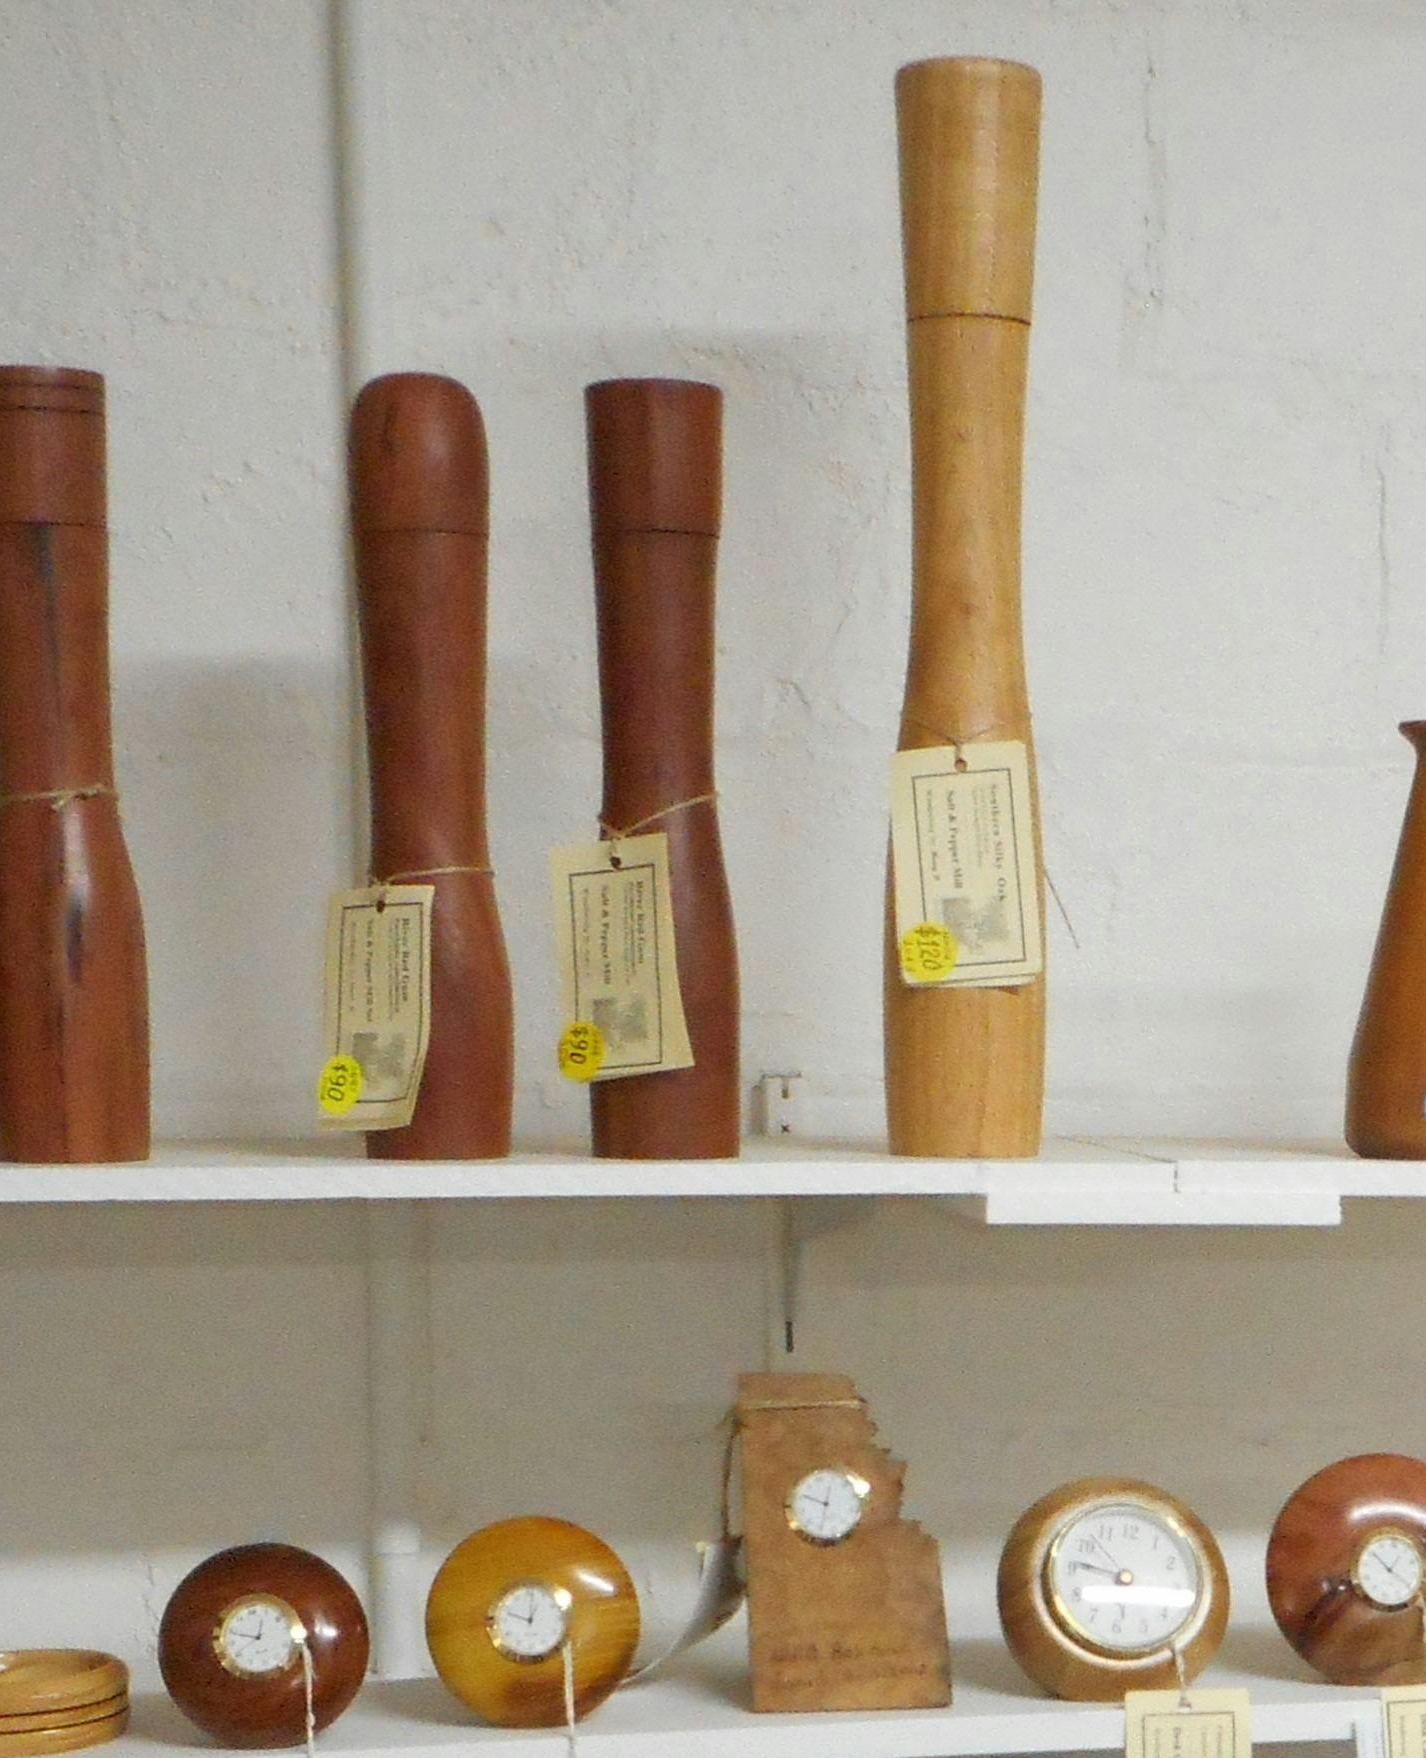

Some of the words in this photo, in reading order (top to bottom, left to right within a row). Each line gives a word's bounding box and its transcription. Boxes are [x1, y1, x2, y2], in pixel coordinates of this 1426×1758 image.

[945, 790, 956, 810] Salt
[947, 827, 960, 863] Pepper
[953, 868, 963, 888] Mill
[913, 924, 942, 971] $120
[567, 1025, 589, 1065] $90
[326, 1063, 348, 1102] $90
